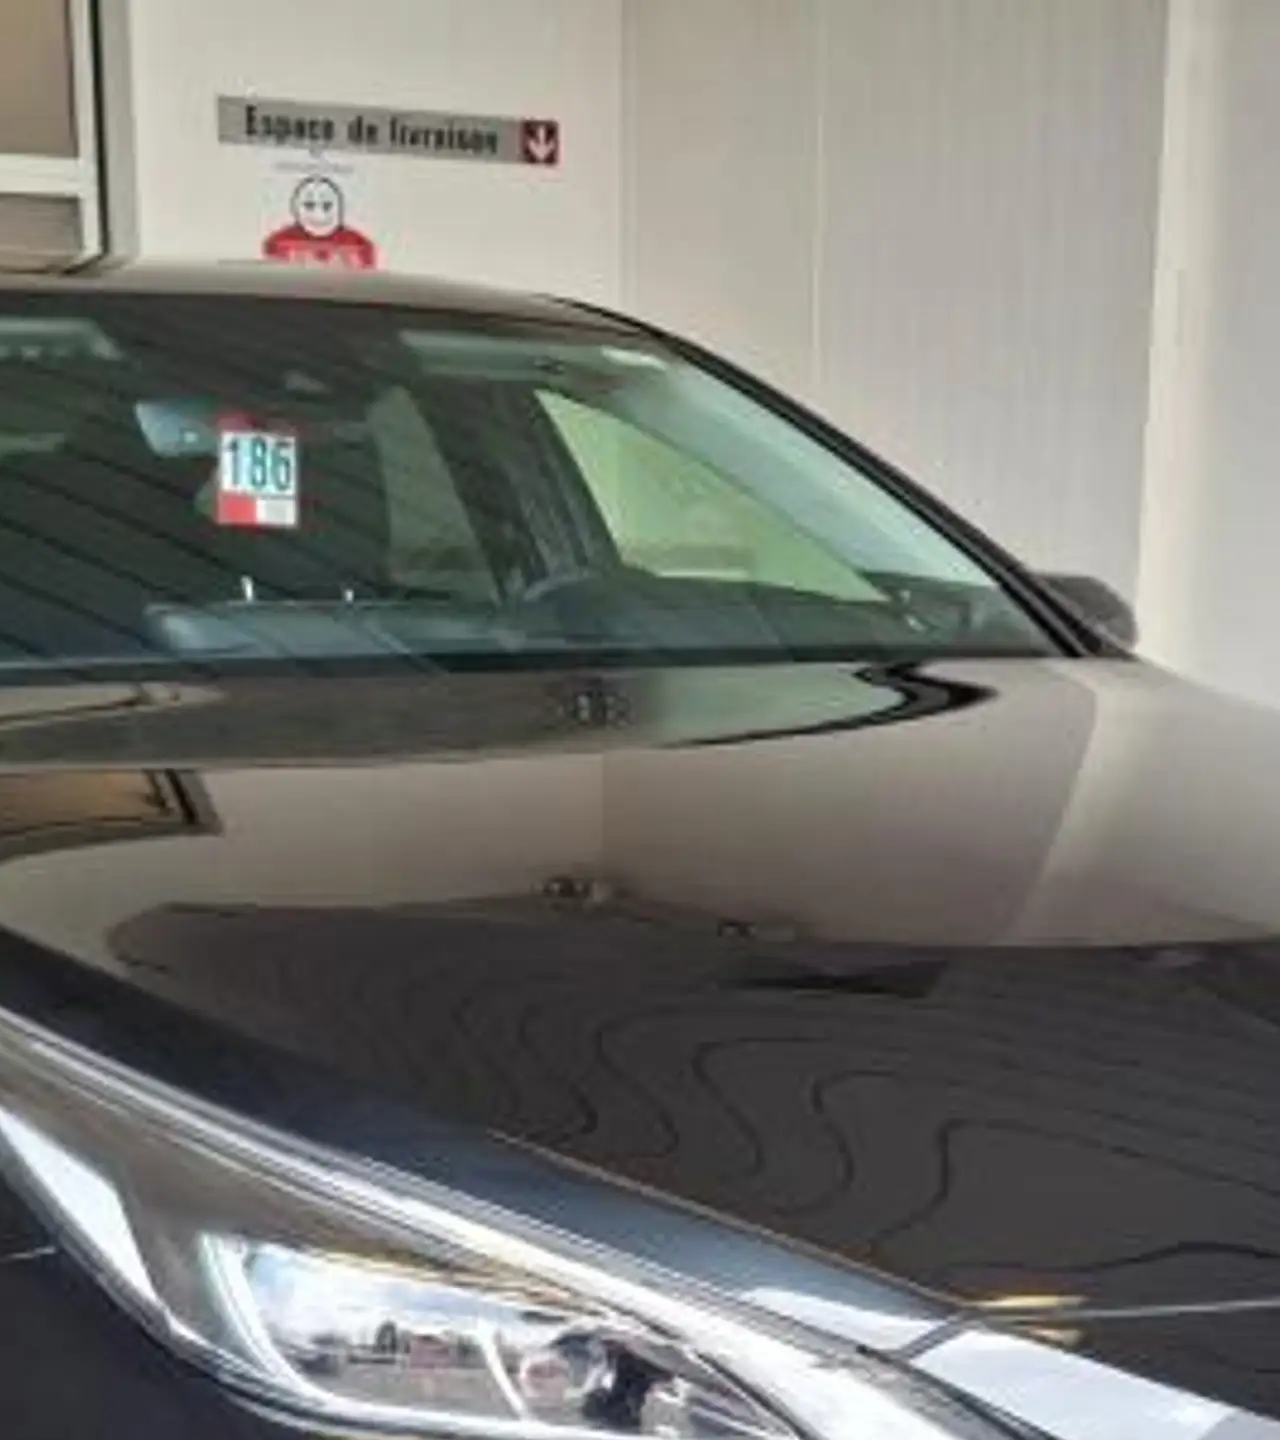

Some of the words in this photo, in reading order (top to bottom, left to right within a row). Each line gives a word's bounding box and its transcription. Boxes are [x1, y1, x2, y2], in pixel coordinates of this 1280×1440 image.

[245, 104, 335, 144] Espace
[347, 115, 380, 145] de
[389, 116, 499, 154] livraison
[222, 435, 292, 491] 186
